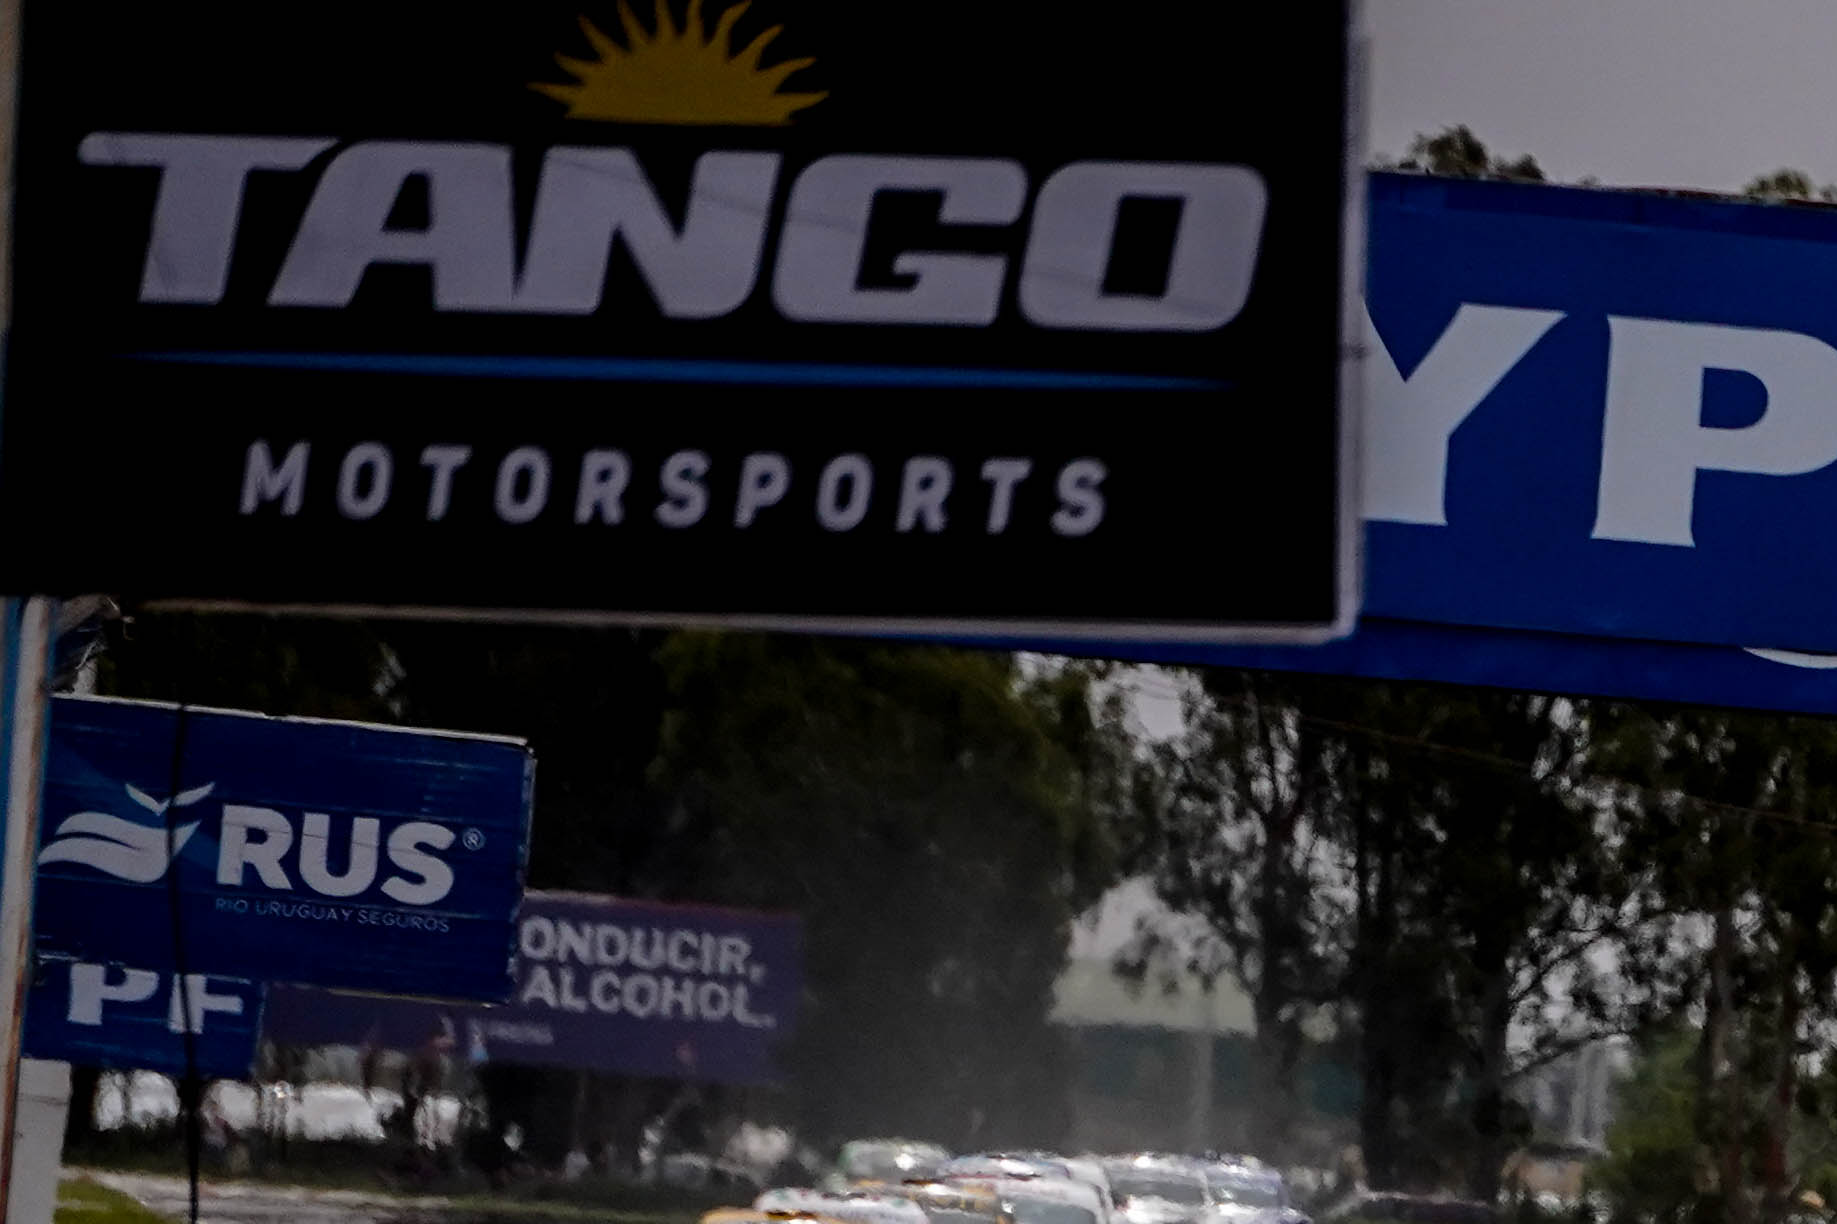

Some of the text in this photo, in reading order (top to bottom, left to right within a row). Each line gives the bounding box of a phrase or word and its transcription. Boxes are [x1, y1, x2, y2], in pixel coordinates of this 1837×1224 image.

[79, 131, 1268, 332] TANGO
[240, 441, 1109, 536] MOTORSPORTS
[216, 804, 456, 906] RUS
[255, 899, 351, 921] URUGUAY
[357, 908, 449, 932] SEGUROS
